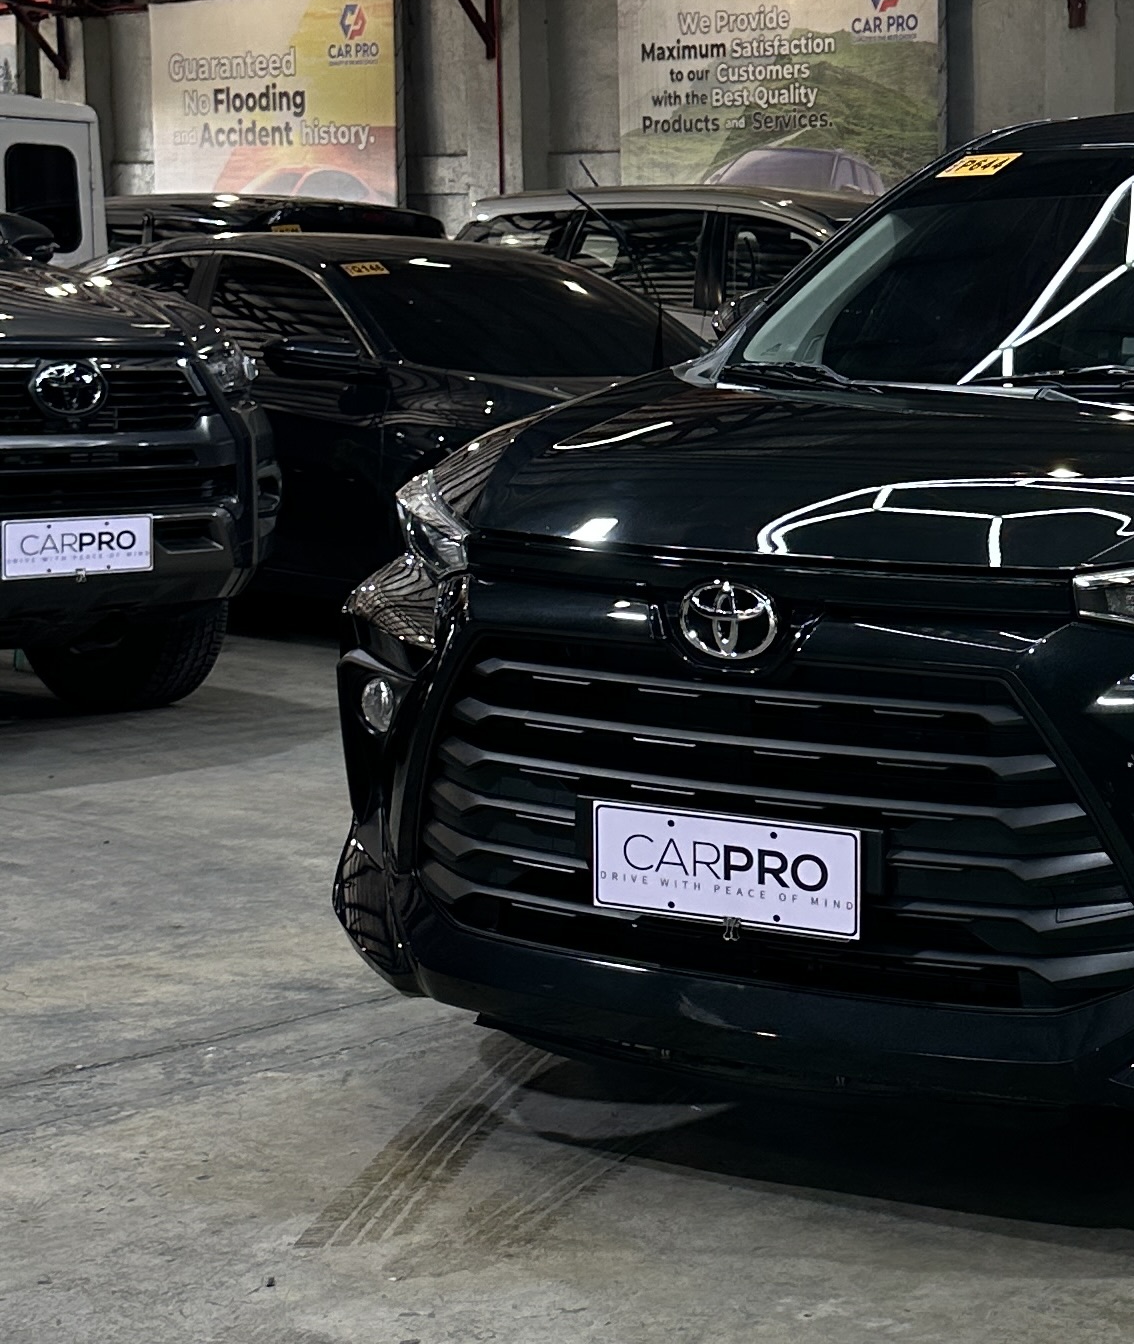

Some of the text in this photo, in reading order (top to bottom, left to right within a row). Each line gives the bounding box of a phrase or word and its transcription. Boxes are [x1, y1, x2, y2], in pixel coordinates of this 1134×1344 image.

[677, 4, 790, 36] We Provide
[851, 14, 918, 34] CAR PRO
[328, 42, 380, 59] CAR PRO
[641, 39, 726, 63] Maximum
[731, 33, 835, 58] Satisfaction
[168, 46, 296, 82] Guaranteed
[669, 62, 810, 83] to our Customers
[183, 82, 306, 117] No Flooding
[652, 82, 818, 109] with the Best Quality
[173, 117, 376, 150] and Accident history.
[642, 108, 833, 134] Products and Services.
[20, 530, 136, 556] CARPRO
[623, 833, 829, 893] CARPRO
[600, 869, 854, 911] DRIVE WITH PEACE OF MIND
